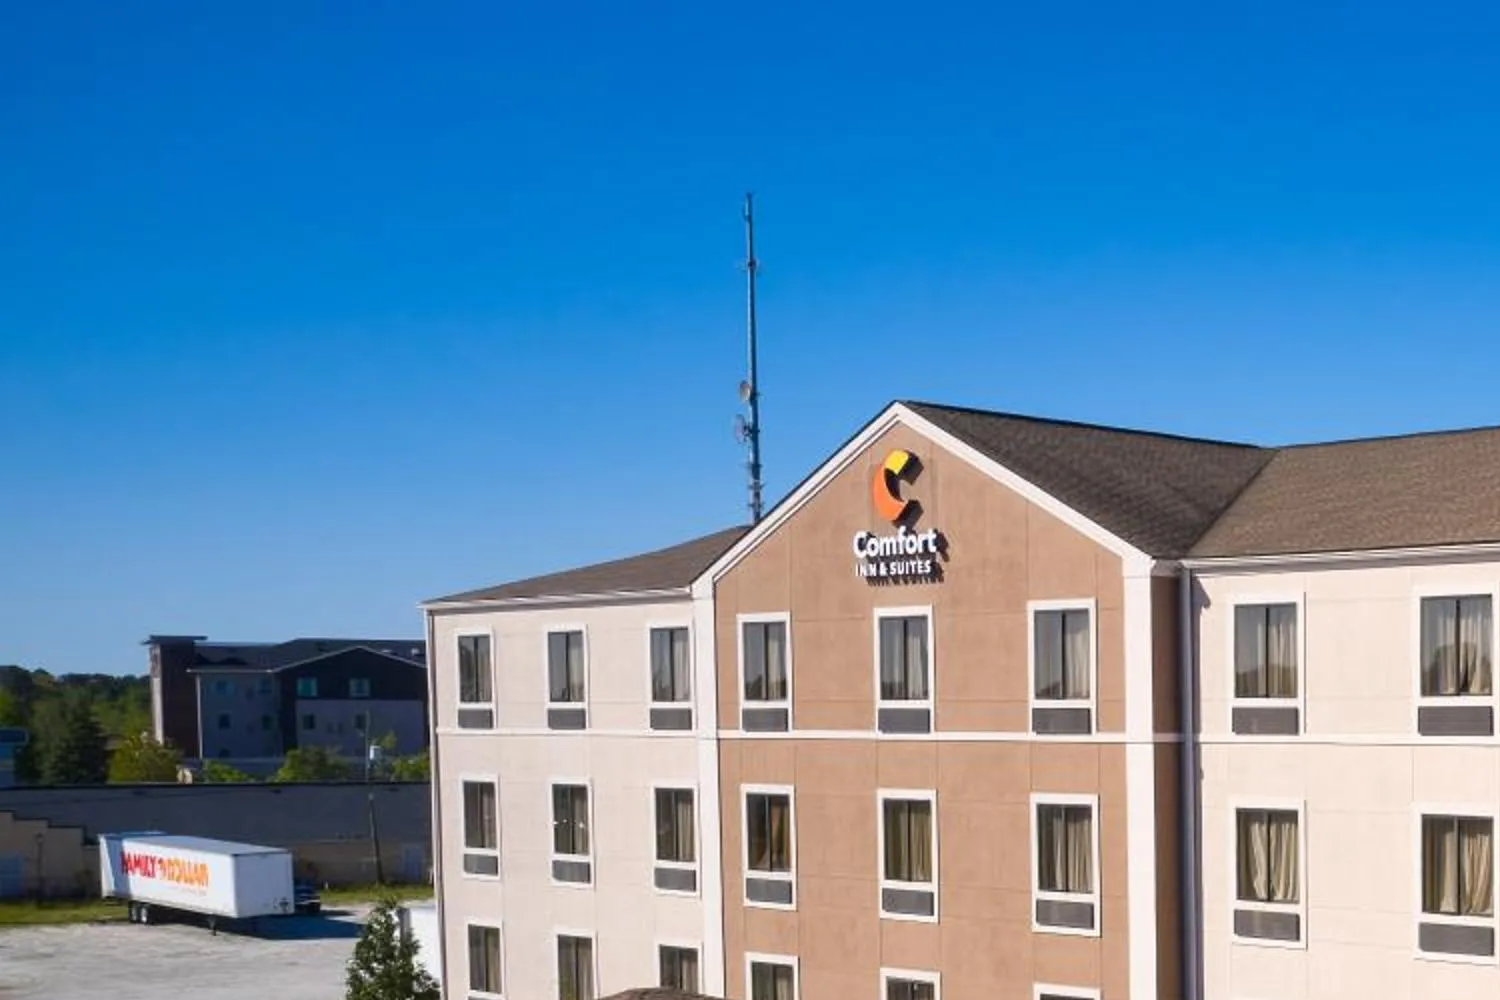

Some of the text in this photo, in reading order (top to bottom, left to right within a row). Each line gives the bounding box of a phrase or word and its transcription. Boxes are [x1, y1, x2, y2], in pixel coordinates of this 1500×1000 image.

[853, 526, 937, 558] Comfort
[855, 560, 932, 577] INN & SUITES
